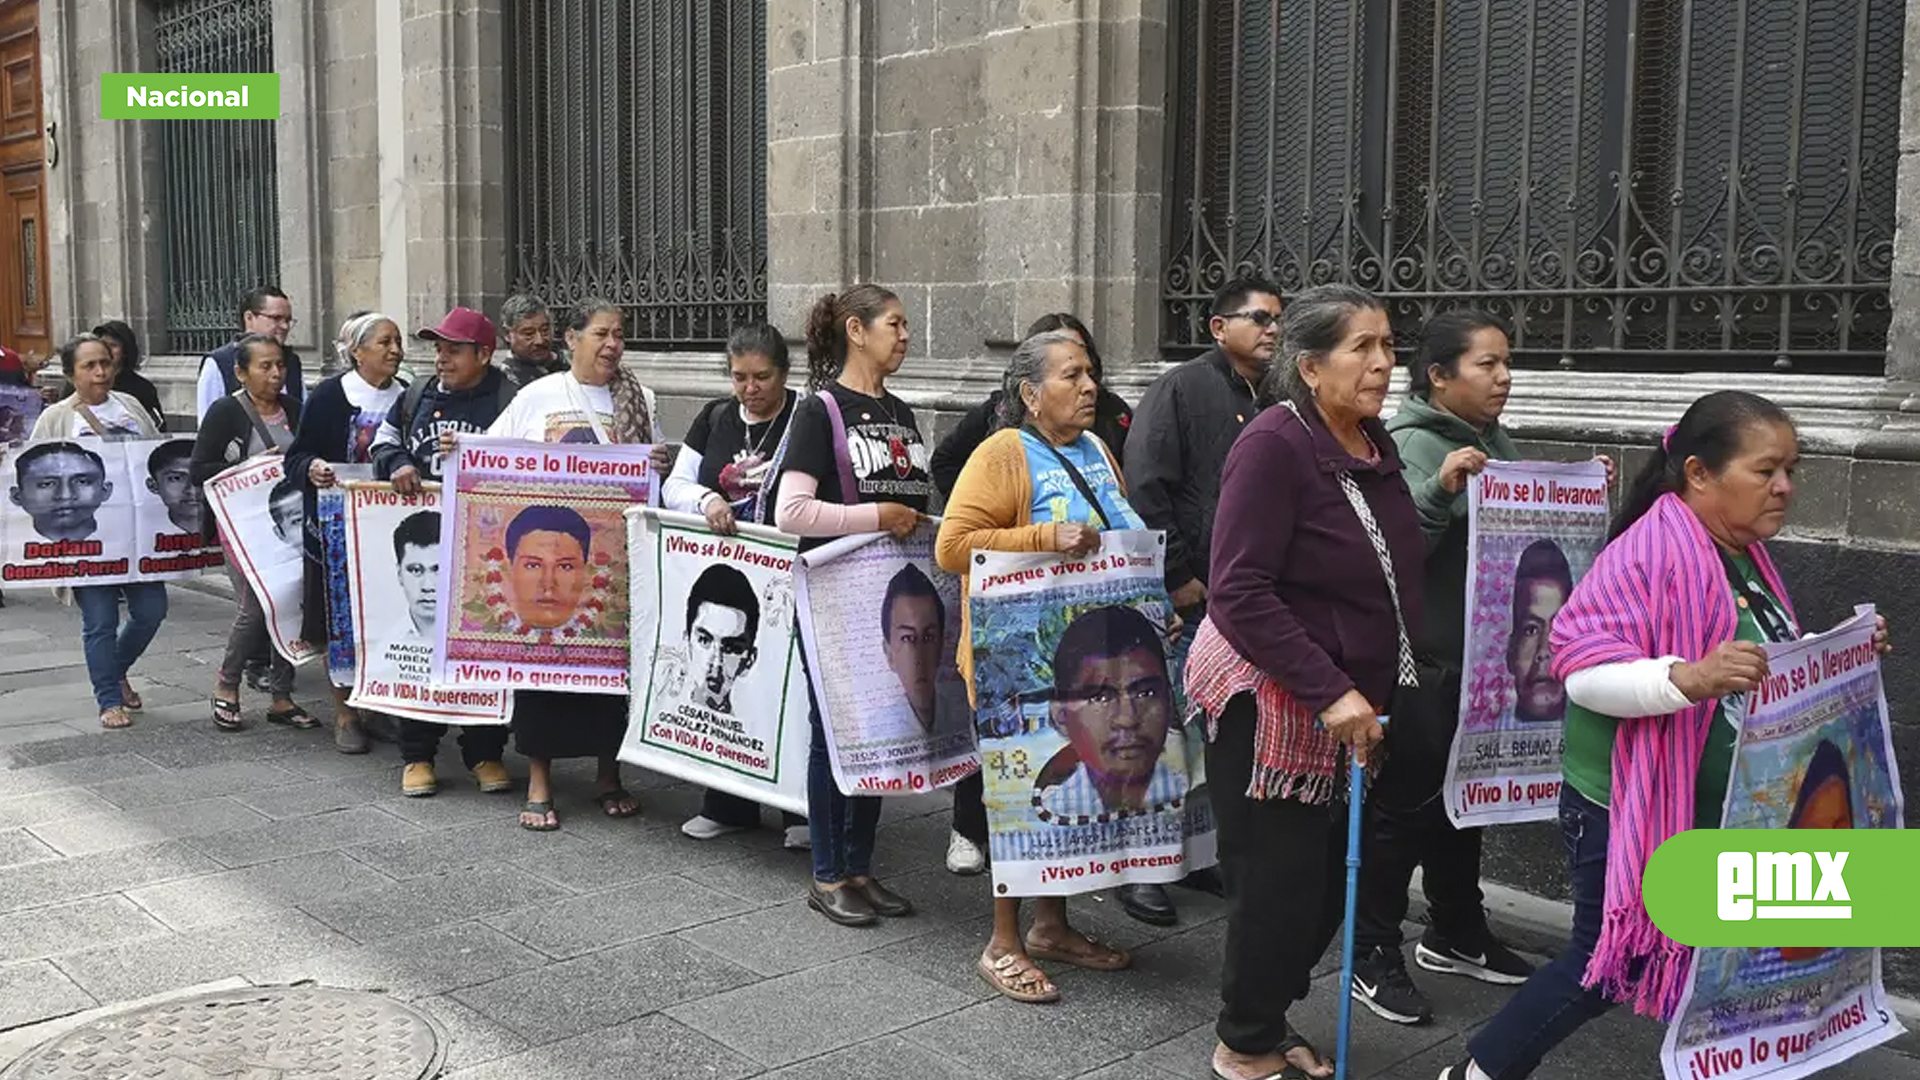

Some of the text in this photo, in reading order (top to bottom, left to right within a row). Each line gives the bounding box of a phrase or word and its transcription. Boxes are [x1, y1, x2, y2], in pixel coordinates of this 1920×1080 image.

[261, 466, 280, 483] se
[461, 449, 509, 470] ¡Vivo
[514, 457, 537, 470] se
[543, 454, 560, 472] lo
[566, 456, 647, 476] llevaron!
[357, 489, 398, 508] ¡Vivo
[401, 492, 418, 506] se
[421, 491, 436, 506] lo
[1478, 474, 1606, 506] ¡Vivo se lo llevaron!
[666, 535, 699, 555] ¡Vivo
[701, 543, 714, 556] se
[717, 541, 731, 558] lo
[982, 568, 1045, 591] ¡Porque
[1049, 561, 1086, 576] vivo
[1091, 559, 1107, 572] se
[1110, 554, 1126, 568] lo
[455, 664, 627, 688] ¡Vivo lo queremos!
[1791, 666, 1806, 693] se
[1807, 654, 1820, 686] lo
[1822, 634, 1876, 681] llevaron!
[393, 683, 417, 699] VIDA
[420, 686, 430, 702] lo
[432, 690, 498, 707] queremos!
[649, 723, 770, 770] ¡Con VIDA lo queremos!
[907, 771, 924, 790] lo
[1462, 782, 1502, 812] ¡Vivo
[1508, 780, 1522, 802] lo
[1042, 864, 1084, 883] ¡Vivo
[1090, 861, 1106, 874] lo
[1750, 1037, 1769, 1065] lo
